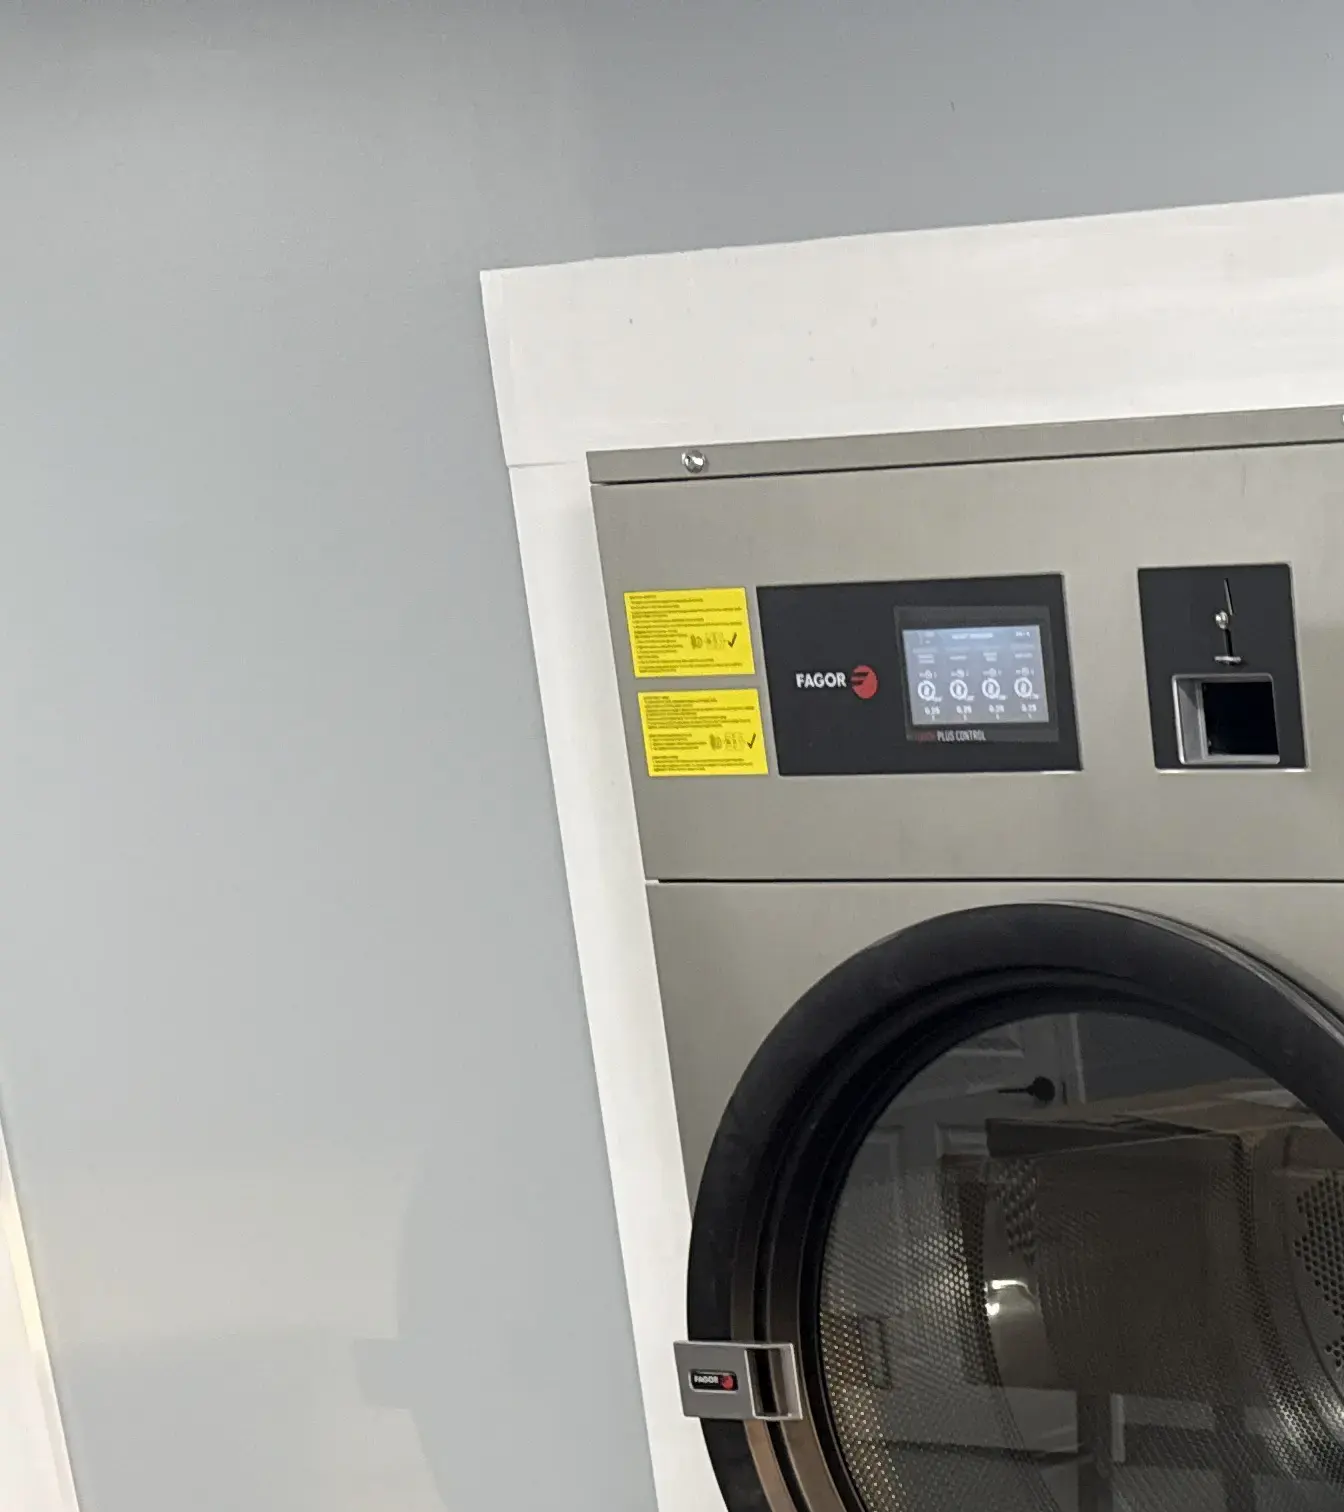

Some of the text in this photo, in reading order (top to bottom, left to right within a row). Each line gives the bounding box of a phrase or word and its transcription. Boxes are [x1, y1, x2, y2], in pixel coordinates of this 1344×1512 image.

[795, 671, 847, 688] FAGOR
[937, 729, 955, 741] PLUS
[955, 729, 987, 741] CONTROL
[693, 1375, 719, 1384] FAGOR
